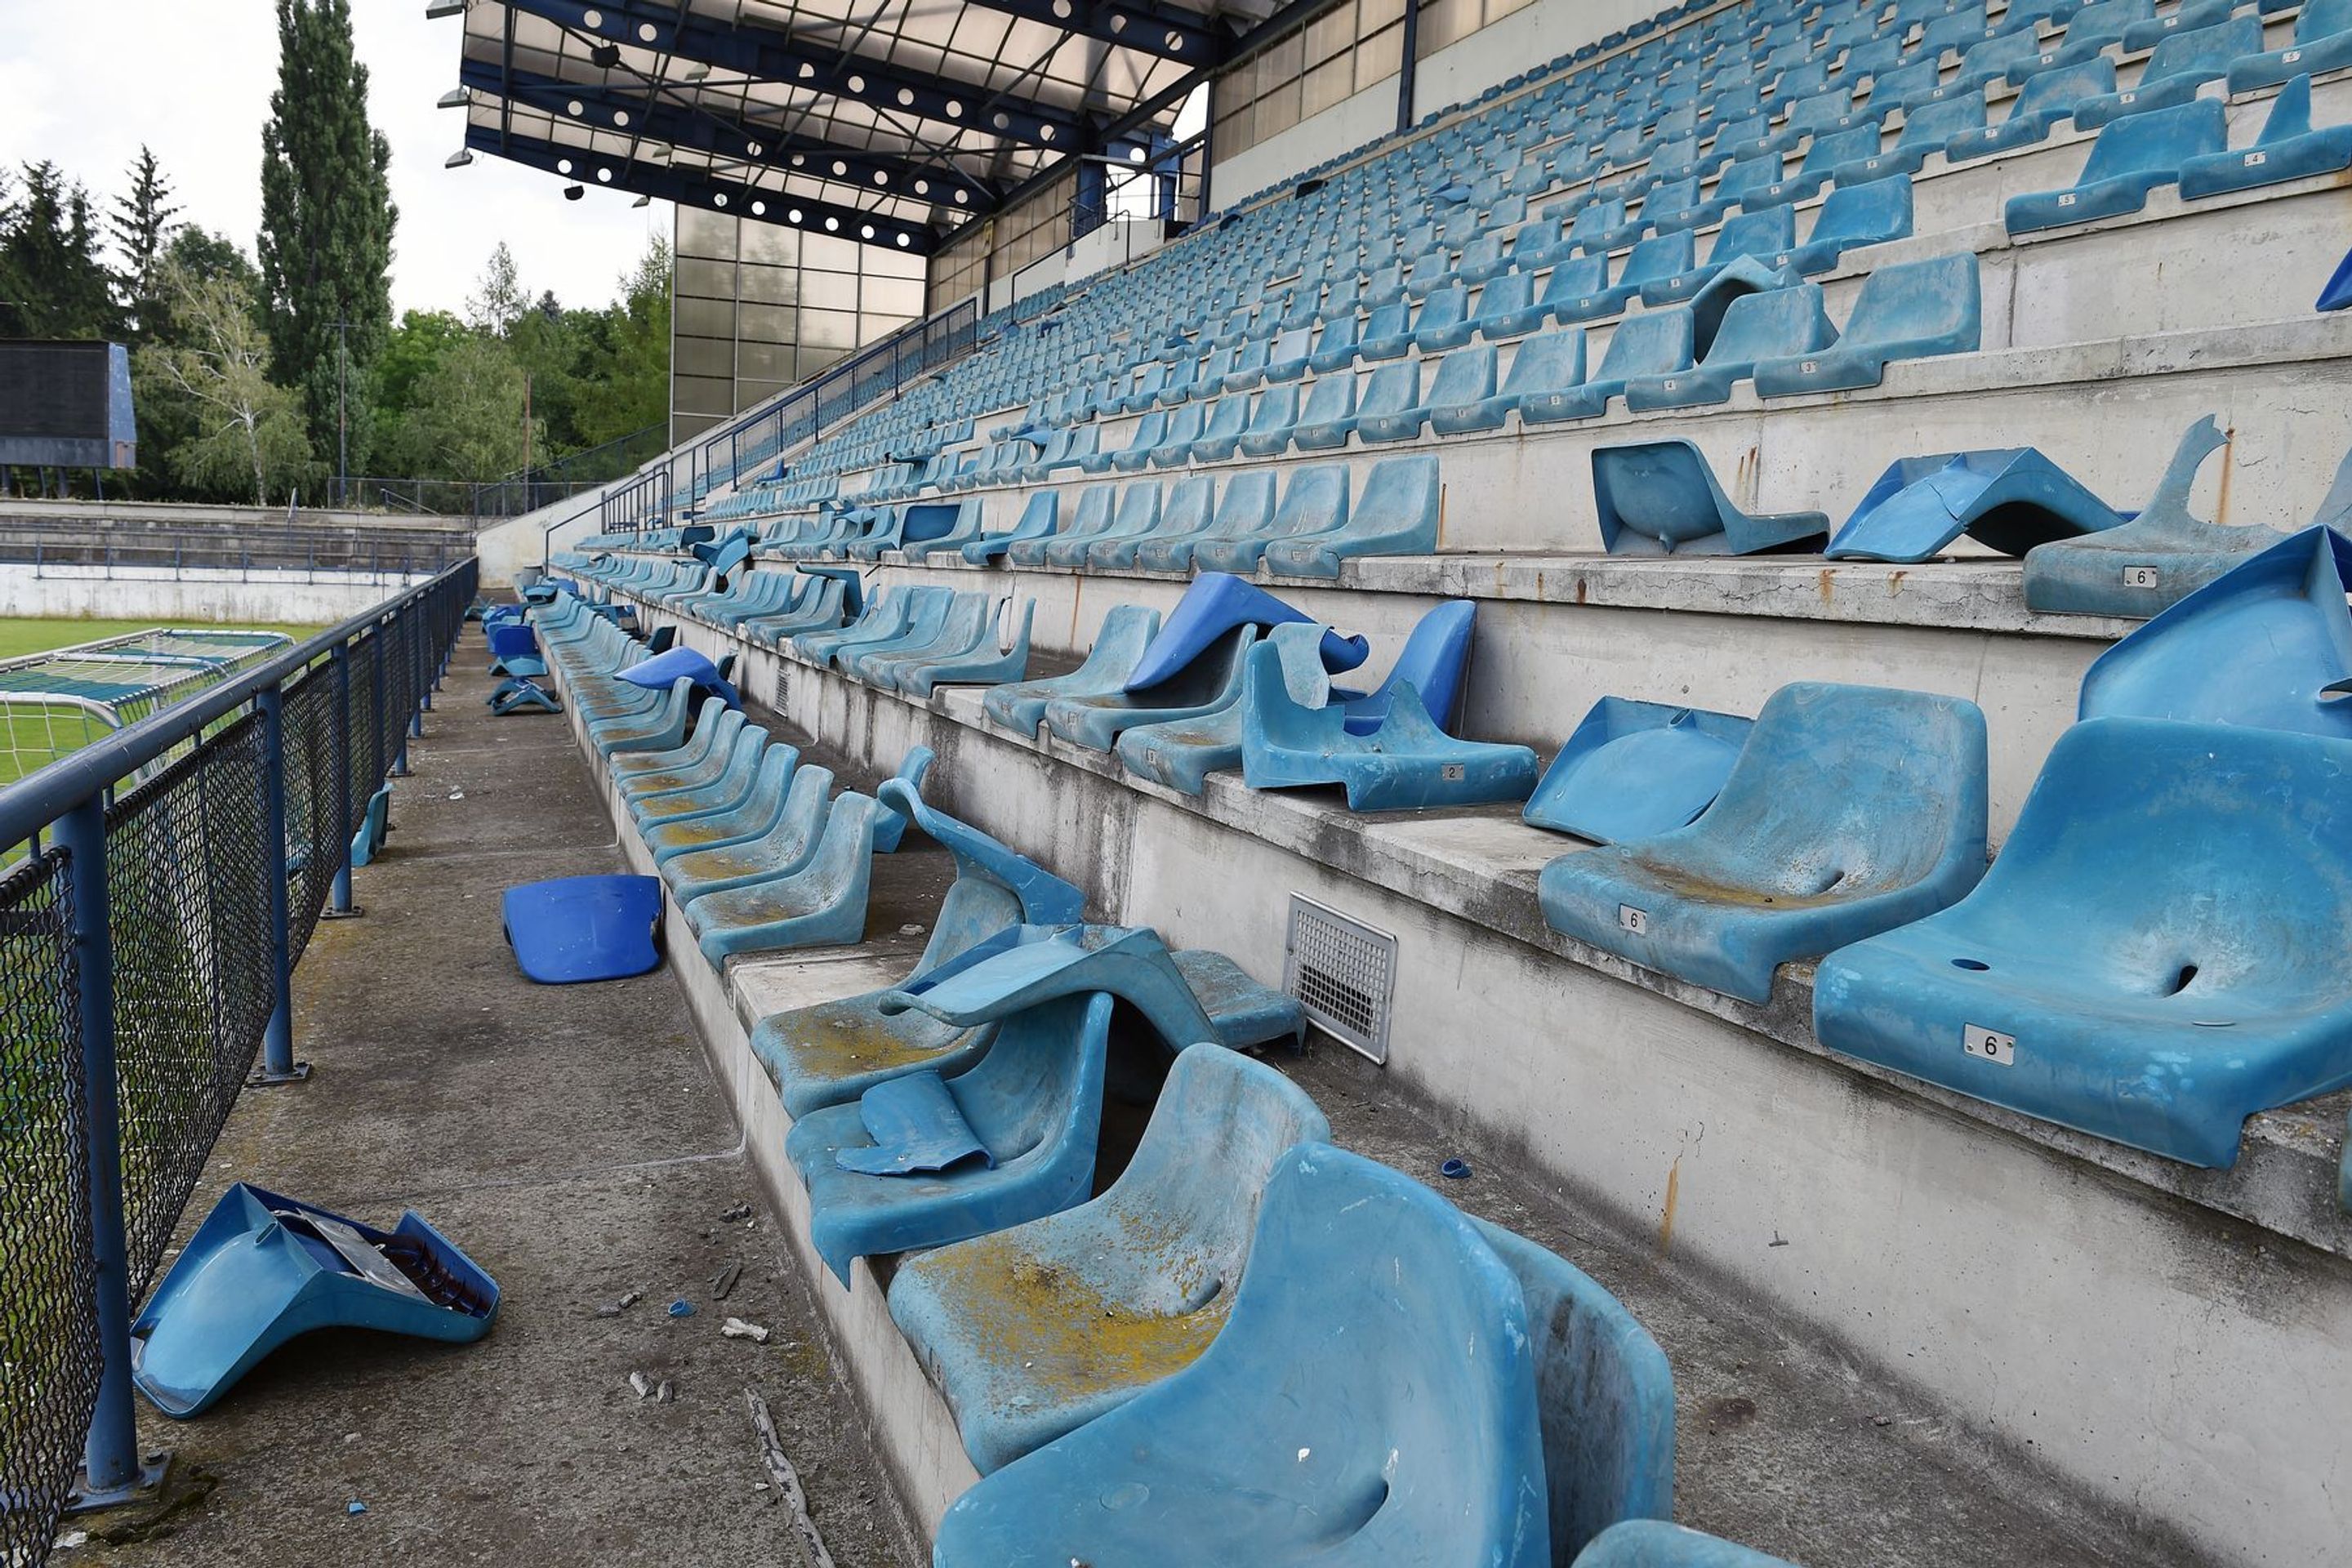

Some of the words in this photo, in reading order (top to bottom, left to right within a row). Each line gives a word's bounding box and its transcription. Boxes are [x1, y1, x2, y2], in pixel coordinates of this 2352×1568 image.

[1806, 363, 1811, 372] 3
[2137, 571, 2145, 584] 6
[1449, 767, 1456, 778] 2
[1630, 913, 1638, 928] 6
[1984, 1036, 1998, 1055] 6
